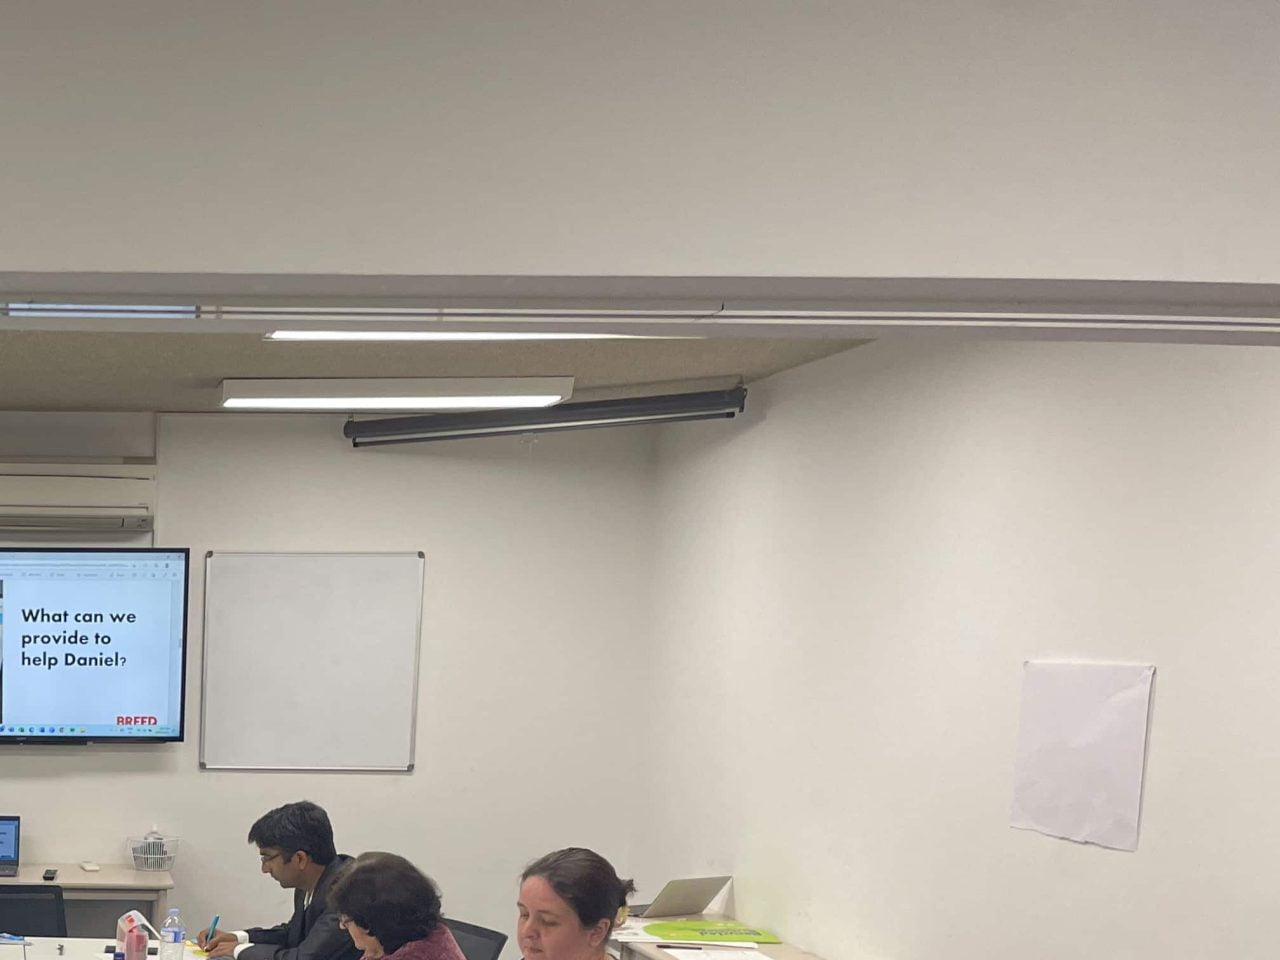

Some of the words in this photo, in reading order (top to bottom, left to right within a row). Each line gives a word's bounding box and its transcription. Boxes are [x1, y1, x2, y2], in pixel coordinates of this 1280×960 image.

[21, 608, 69, 623] What
[74, 613, 104, 623] can
[109, 613, 137, 623] we
[21, 630, 89, 648] provide
[94, 632, 112, 645] to
[21, 651, 58, 670] help
[64, 651, 127, 666] Daniel?
